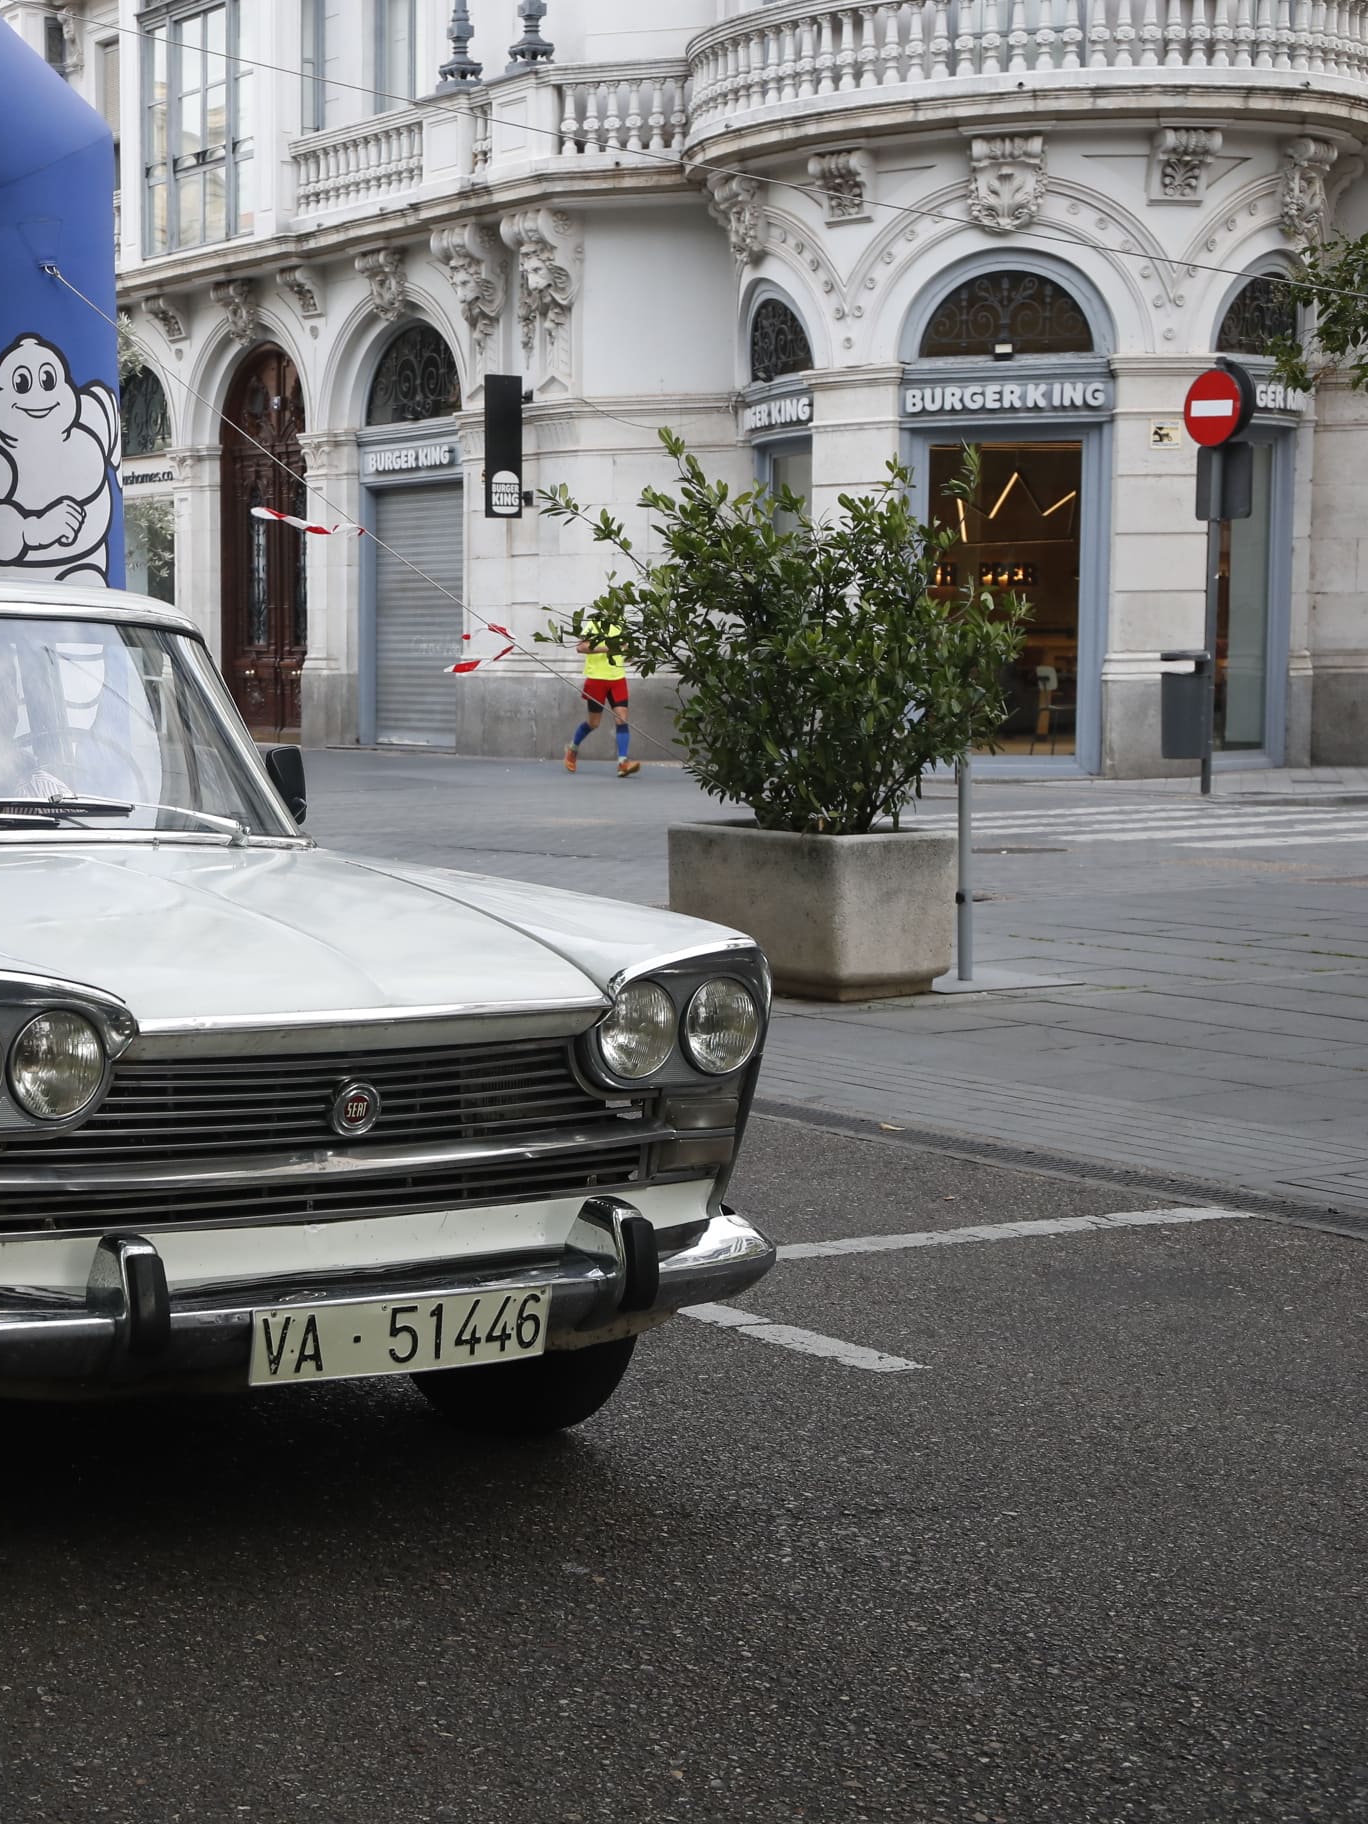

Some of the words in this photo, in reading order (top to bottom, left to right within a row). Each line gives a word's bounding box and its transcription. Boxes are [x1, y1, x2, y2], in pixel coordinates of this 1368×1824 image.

[771, 397, 810, 424] KING
[905, 384, 1022, 413] BURGER
[1026, 382, 1105, 408] KING
[369, 449, 416, 472] BURGER
[418, 445, 450, 467] KING
[492, 483, 520, 494] BURGER
[492, 493, 520, 506] KING
[346, 1102, 368, 1118] SEAT
[262, 1314, 323, 1375] VA
[388, 1293, 542, 1363] 51446
